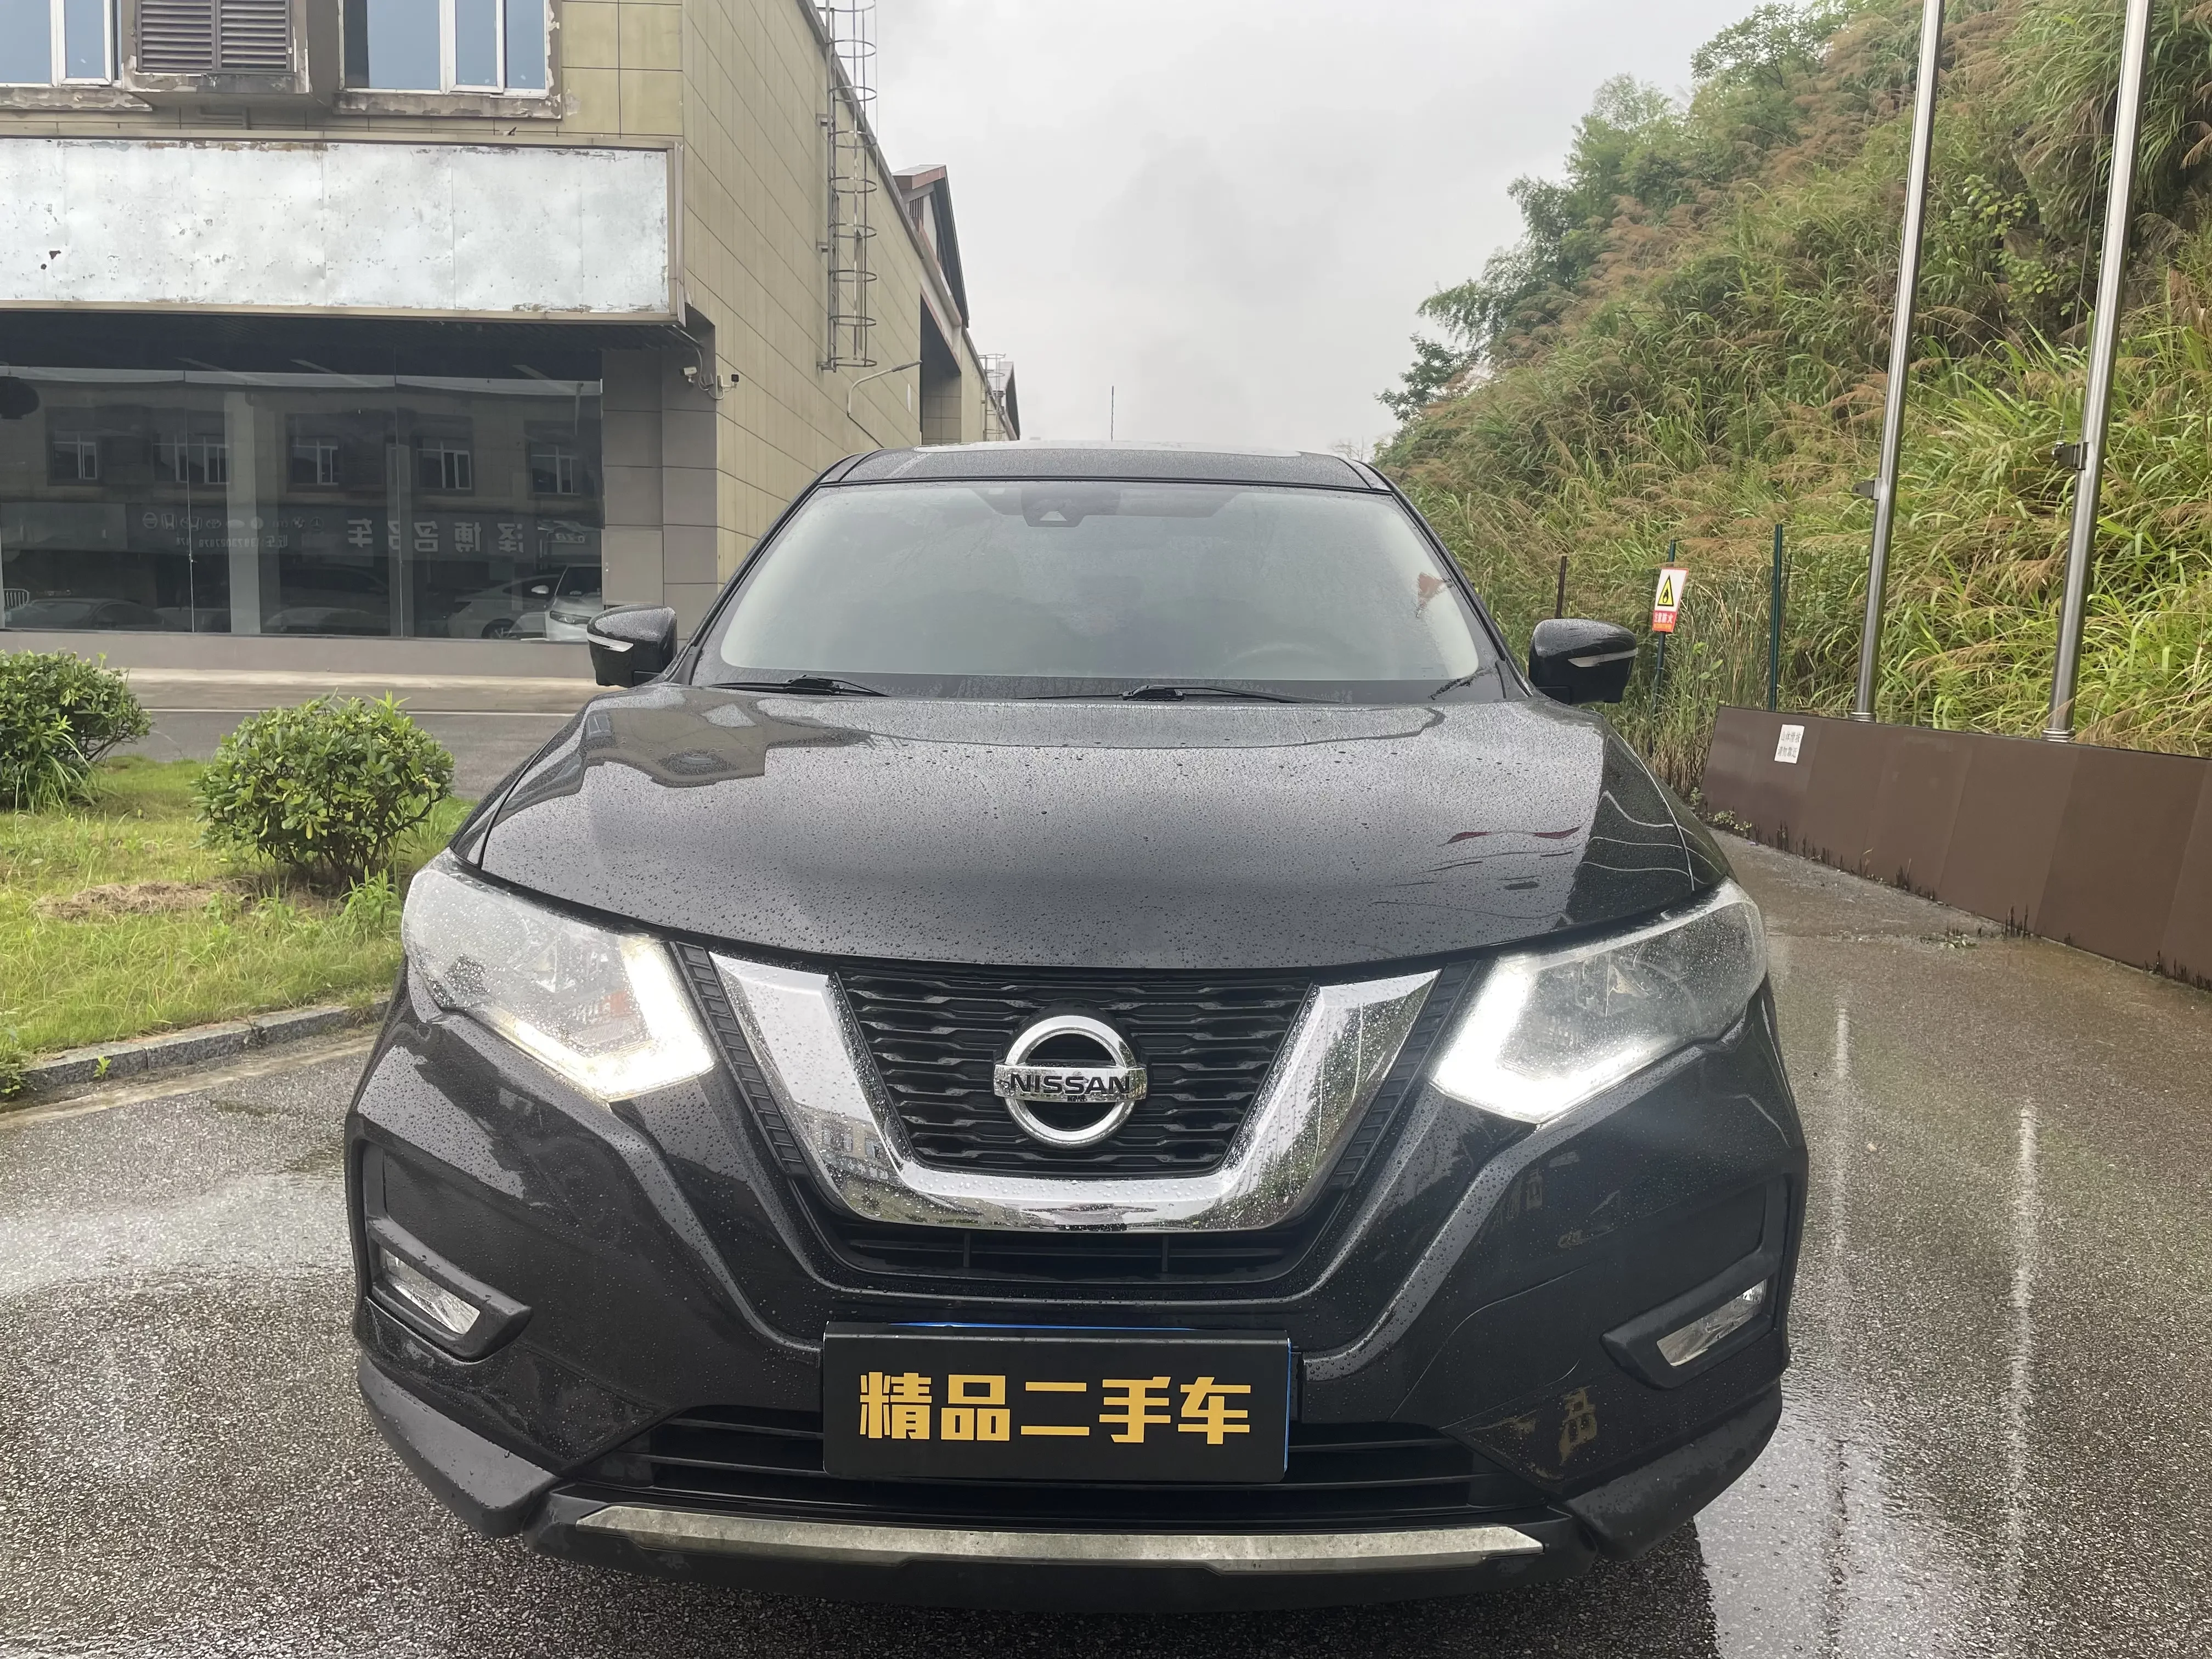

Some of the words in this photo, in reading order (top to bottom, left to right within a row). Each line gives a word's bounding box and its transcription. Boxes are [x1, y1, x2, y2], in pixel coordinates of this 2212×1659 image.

[1011, 1073, 1130, 1094] NISSAN
[859, 1371, 1251, 1444] 精品二手车
